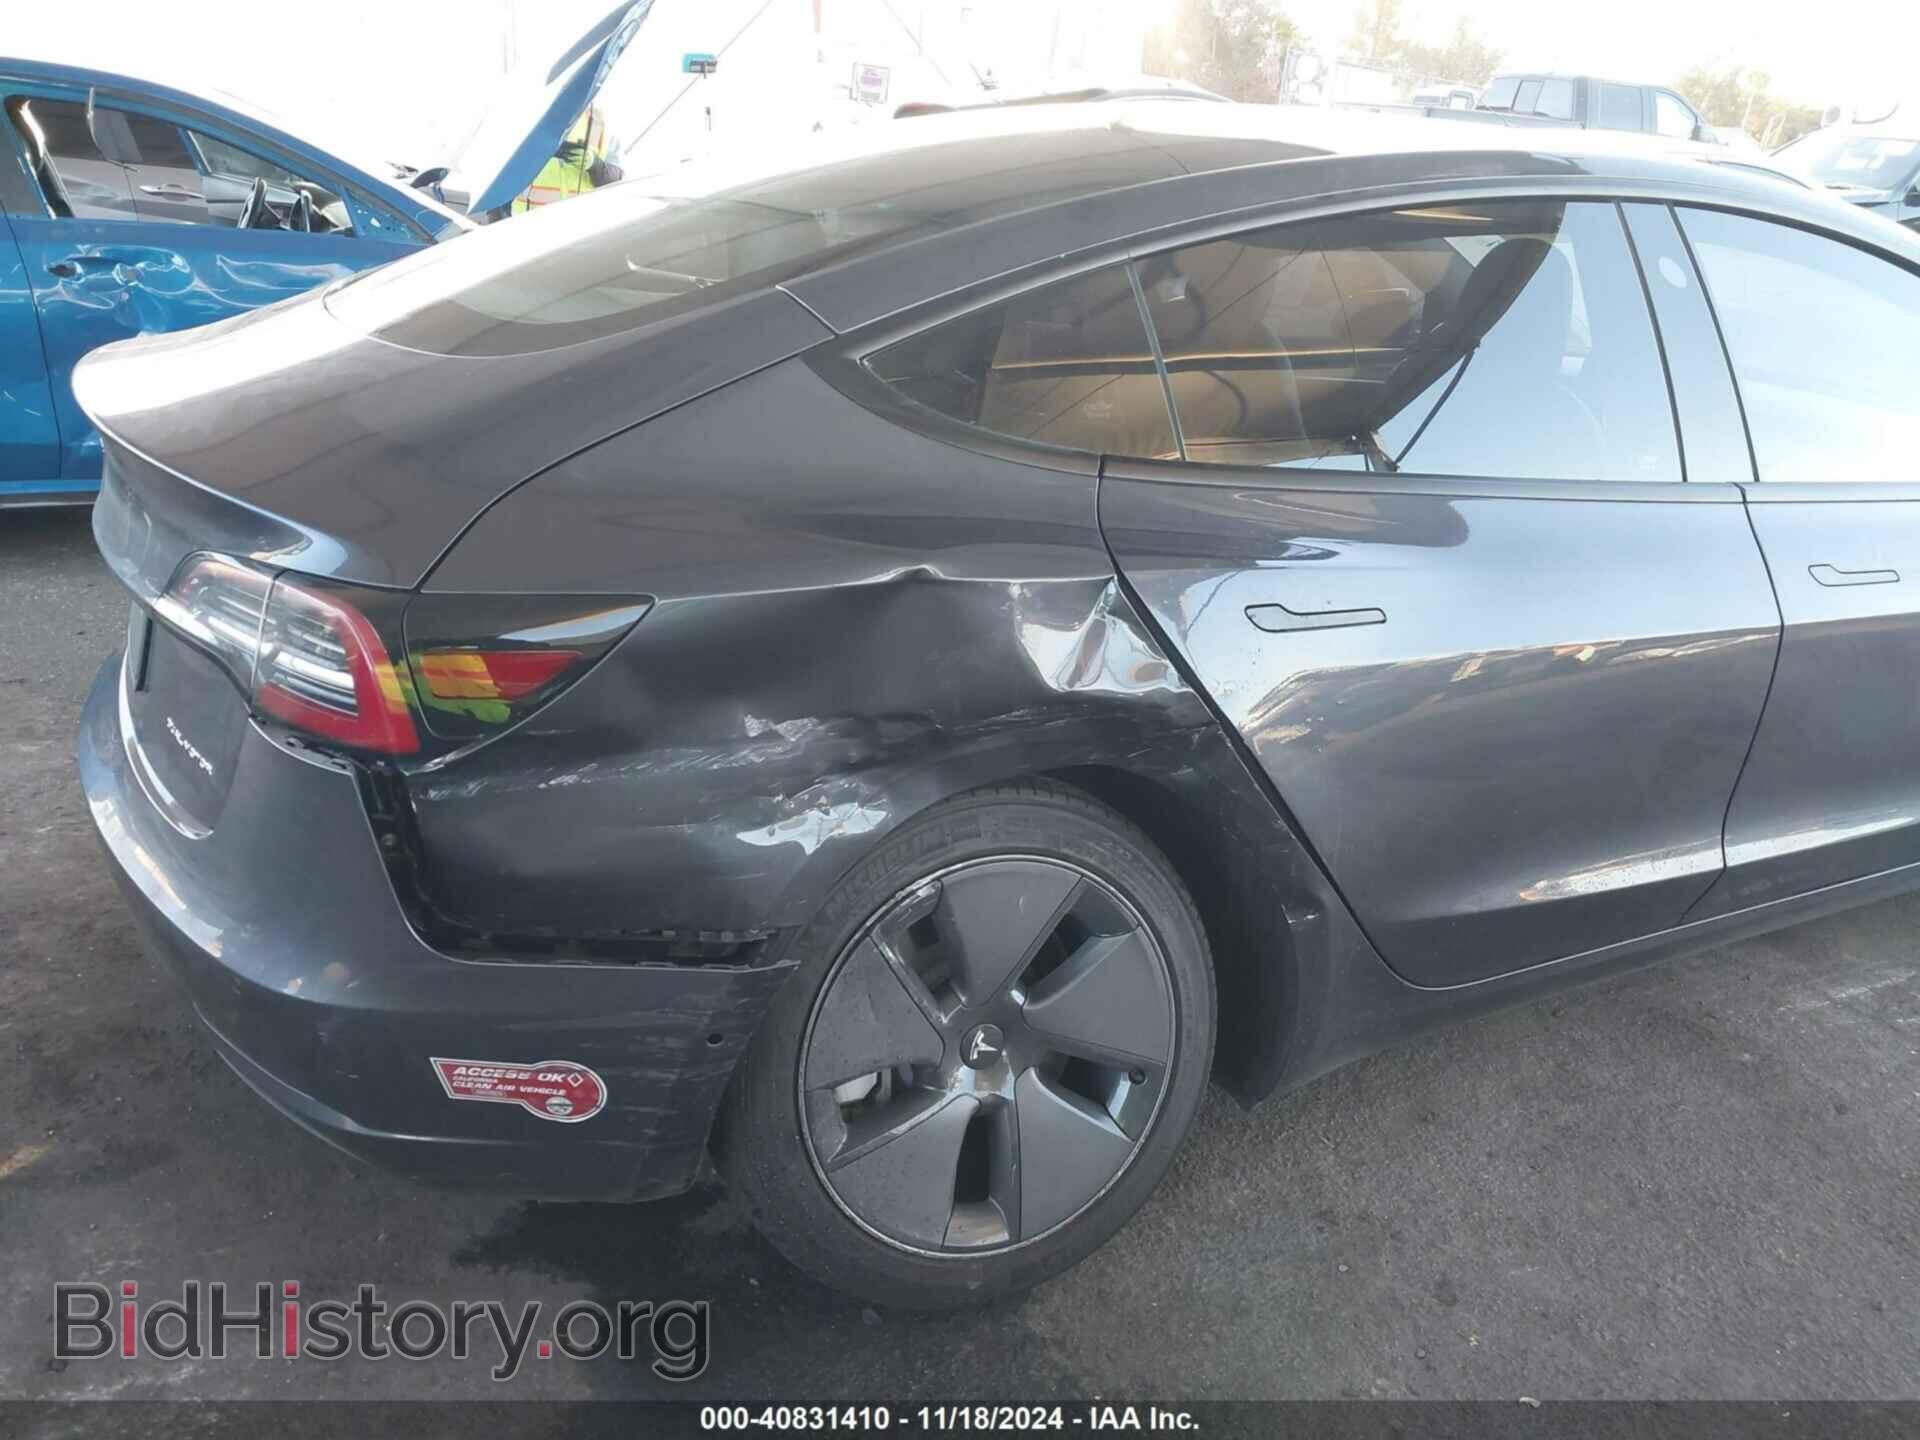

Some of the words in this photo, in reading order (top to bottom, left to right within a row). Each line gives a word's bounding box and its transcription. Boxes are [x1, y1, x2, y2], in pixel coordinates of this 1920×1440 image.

[453, 1066, 531, 1080] ACCESS
[537, 1071, 567, 1083] OK
[452, 1080, 492, 1089] CLEAN
[495, 1083, 517, 1092] AIR
[519, 1085, 566, 1096] VEHICLE
